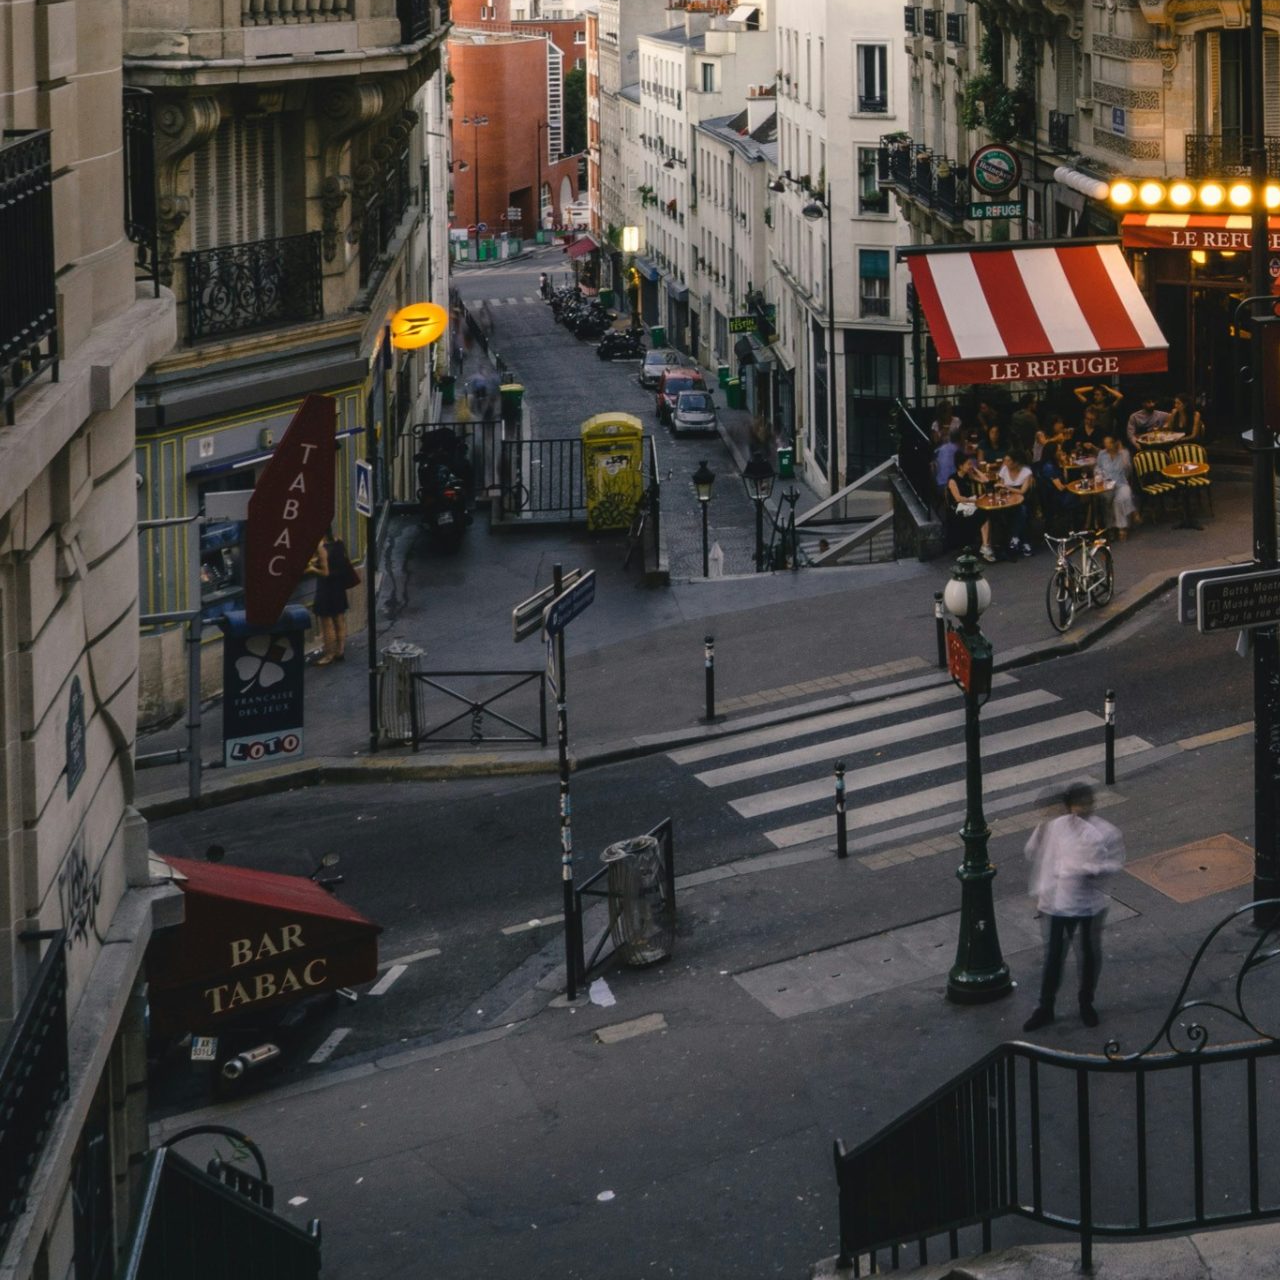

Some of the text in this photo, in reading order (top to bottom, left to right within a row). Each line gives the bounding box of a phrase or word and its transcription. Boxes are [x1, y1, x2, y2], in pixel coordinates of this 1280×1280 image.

[972, 205, 1021, 218] Le REFUGE
[1171, 231, 1198, 247] LE
[990, 356, 1120, 380] LE REFUGE
[268, 443, 318, 577] TABAC
[262, 703, 290, 716] JEUX
[230, 734, 300, 761] LOTO
[229, 923, 306, 969] BAR
[204, 958, 328, 1014] TABAC
